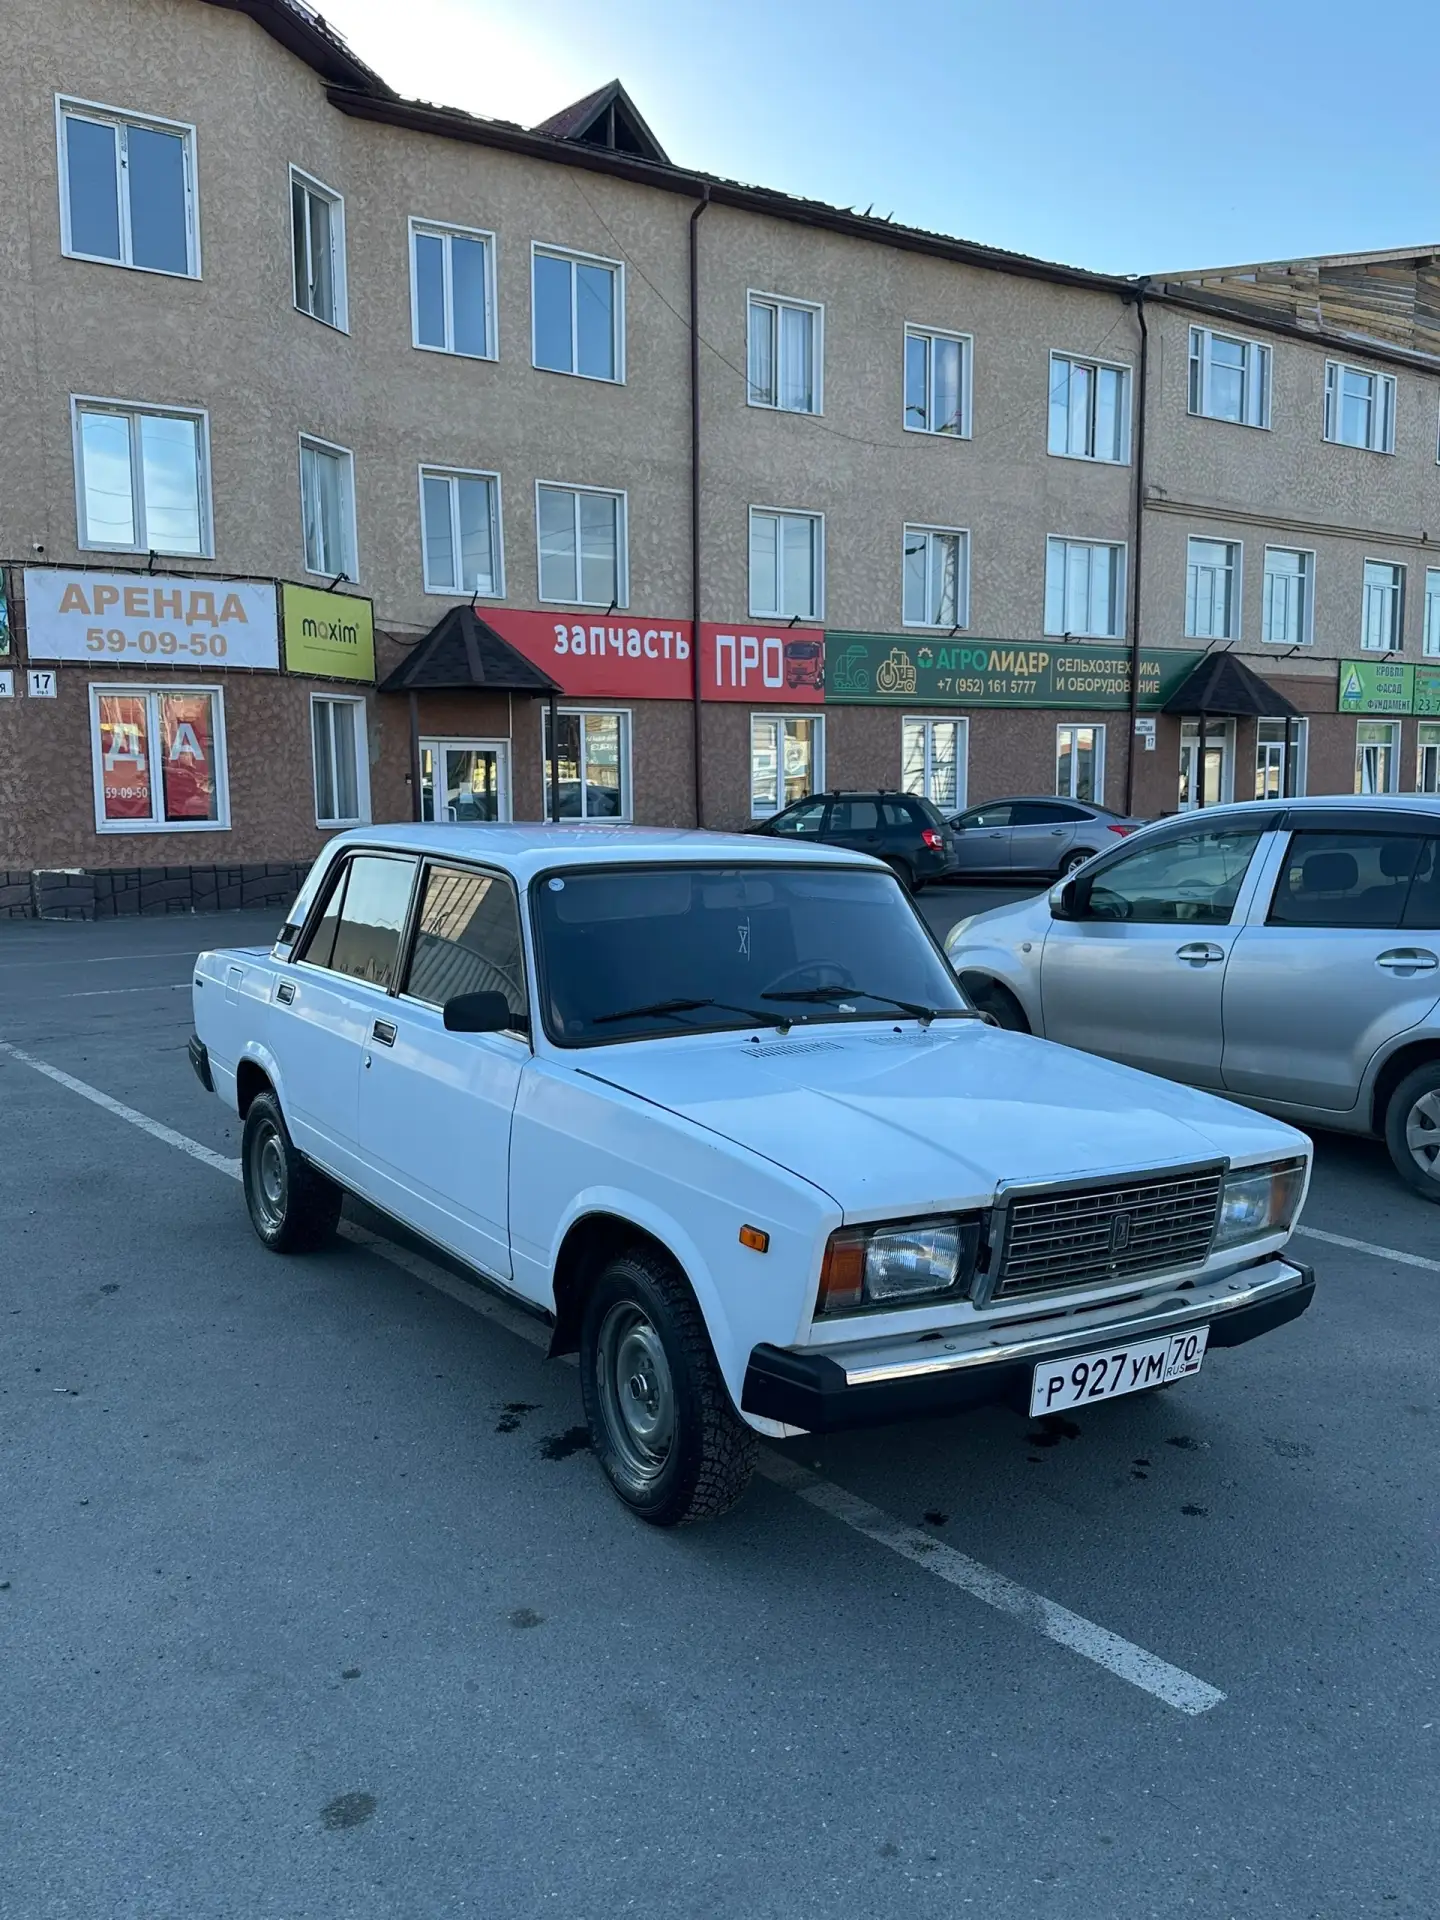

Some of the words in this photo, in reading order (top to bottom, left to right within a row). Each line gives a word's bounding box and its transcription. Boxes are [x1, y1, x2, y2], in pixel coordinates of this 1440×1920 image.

[59, 583, 248, 627] АРЕНДА
[302, 618, 358, 644] maxim
[86, 628, 227, 657] 59-09-50
[716, 635, 783, 688] ПРО
[936, 647, 1050, 676] АГРОЛИДЕР
[1056, 658, 1161, 676] СЕЛЬХОЗТЕХИКА
[1376, 666, 1404, 677] КРОВЛЯ
[33, 674, 51, 689] 17
[937, 678, 952, 691] +7
[955, 679, 984, 695] (952)
[988, 680, 1006, 693] 161
[1010, 680, 1036, 693] 5777
[1056, 677, 1065, 691] И
[1068, 677, 1160, 694] ОБОРУДОВНИЕ
[1376, 683, 1402, 694] ФАСАД
[1367, 700, 1411, 710] ФУНДАМЕНТ
[105, 787, 148, 799] 59-09-50
[1171, 1335, 1198, 1366] 70
[1166, 1364, 1185, 1377] RUS
